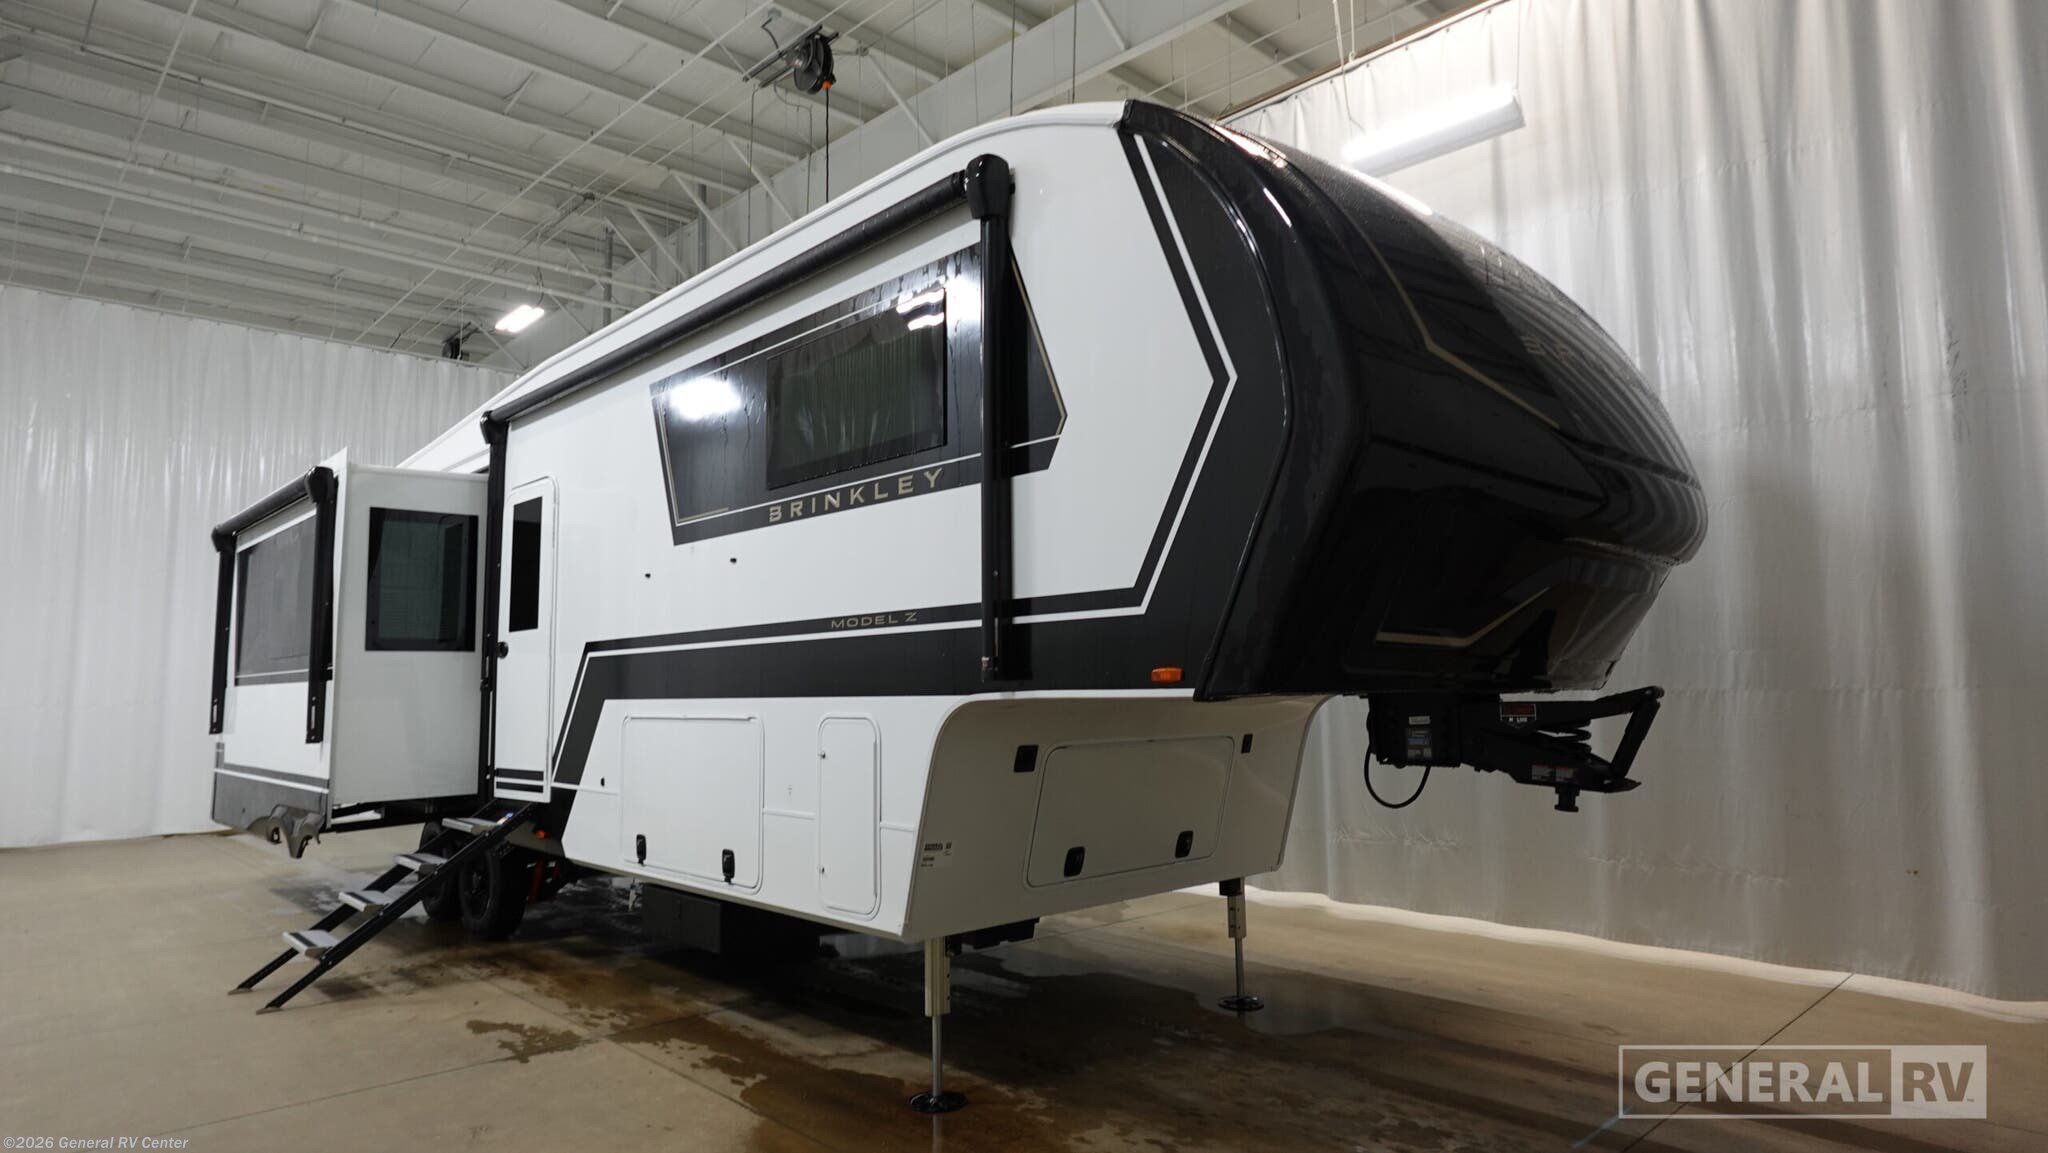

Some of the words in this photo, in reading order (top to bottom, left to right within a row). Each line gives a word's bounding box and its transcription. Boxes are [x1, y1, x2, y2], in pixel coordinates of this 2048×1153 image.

[768, 467, 944, 522] BRINKLEY
[830, 614, 898, 629] MODEL
[904, 611, 918, 622] Z
